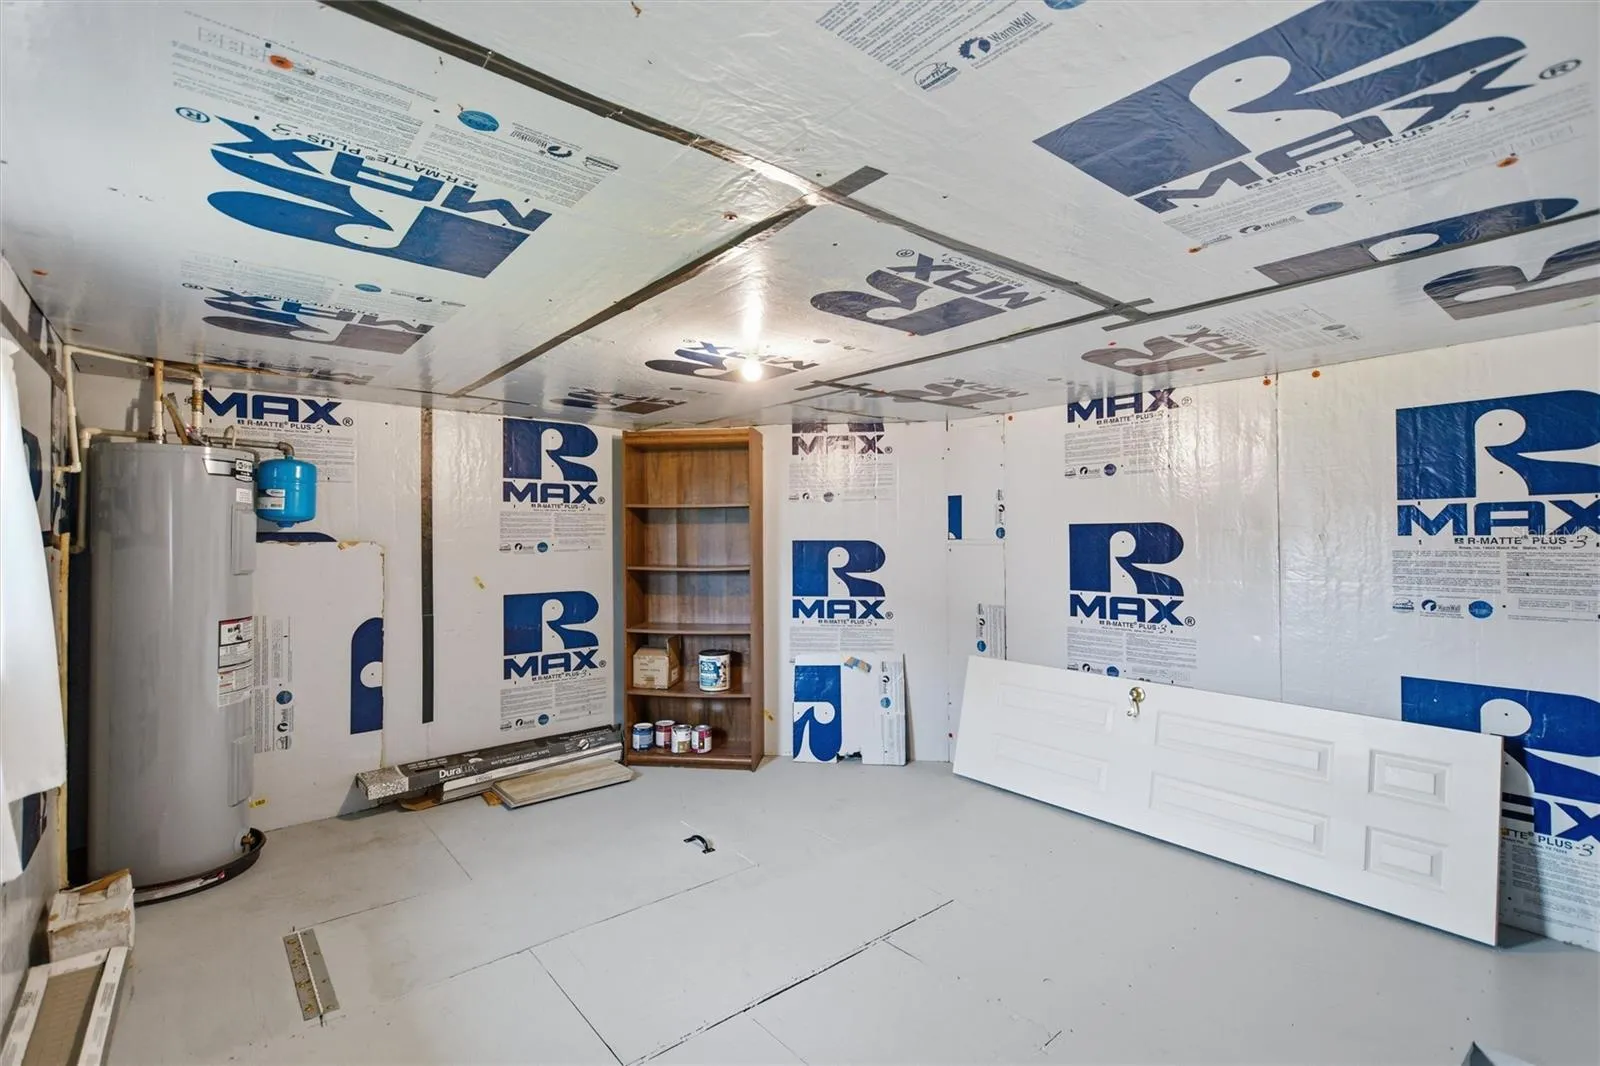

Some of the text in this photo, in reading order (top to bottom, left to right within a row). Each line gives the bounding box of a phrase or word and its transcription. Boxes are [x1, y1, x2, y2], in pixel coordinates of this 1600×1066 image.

[987, 11, 1037, 43] WarmWall
[207, 147, 531, 279] R
[810, 268, 1008, 337] R
[503, 417, 599, 483] R
[1395, 389, 1600, 501] R
[792, 539, 887, 597] R
[1068, 522, 1185, 597] R
[503, 590, 600, 657] R
[439, 762, 477, 780] DuraLux
